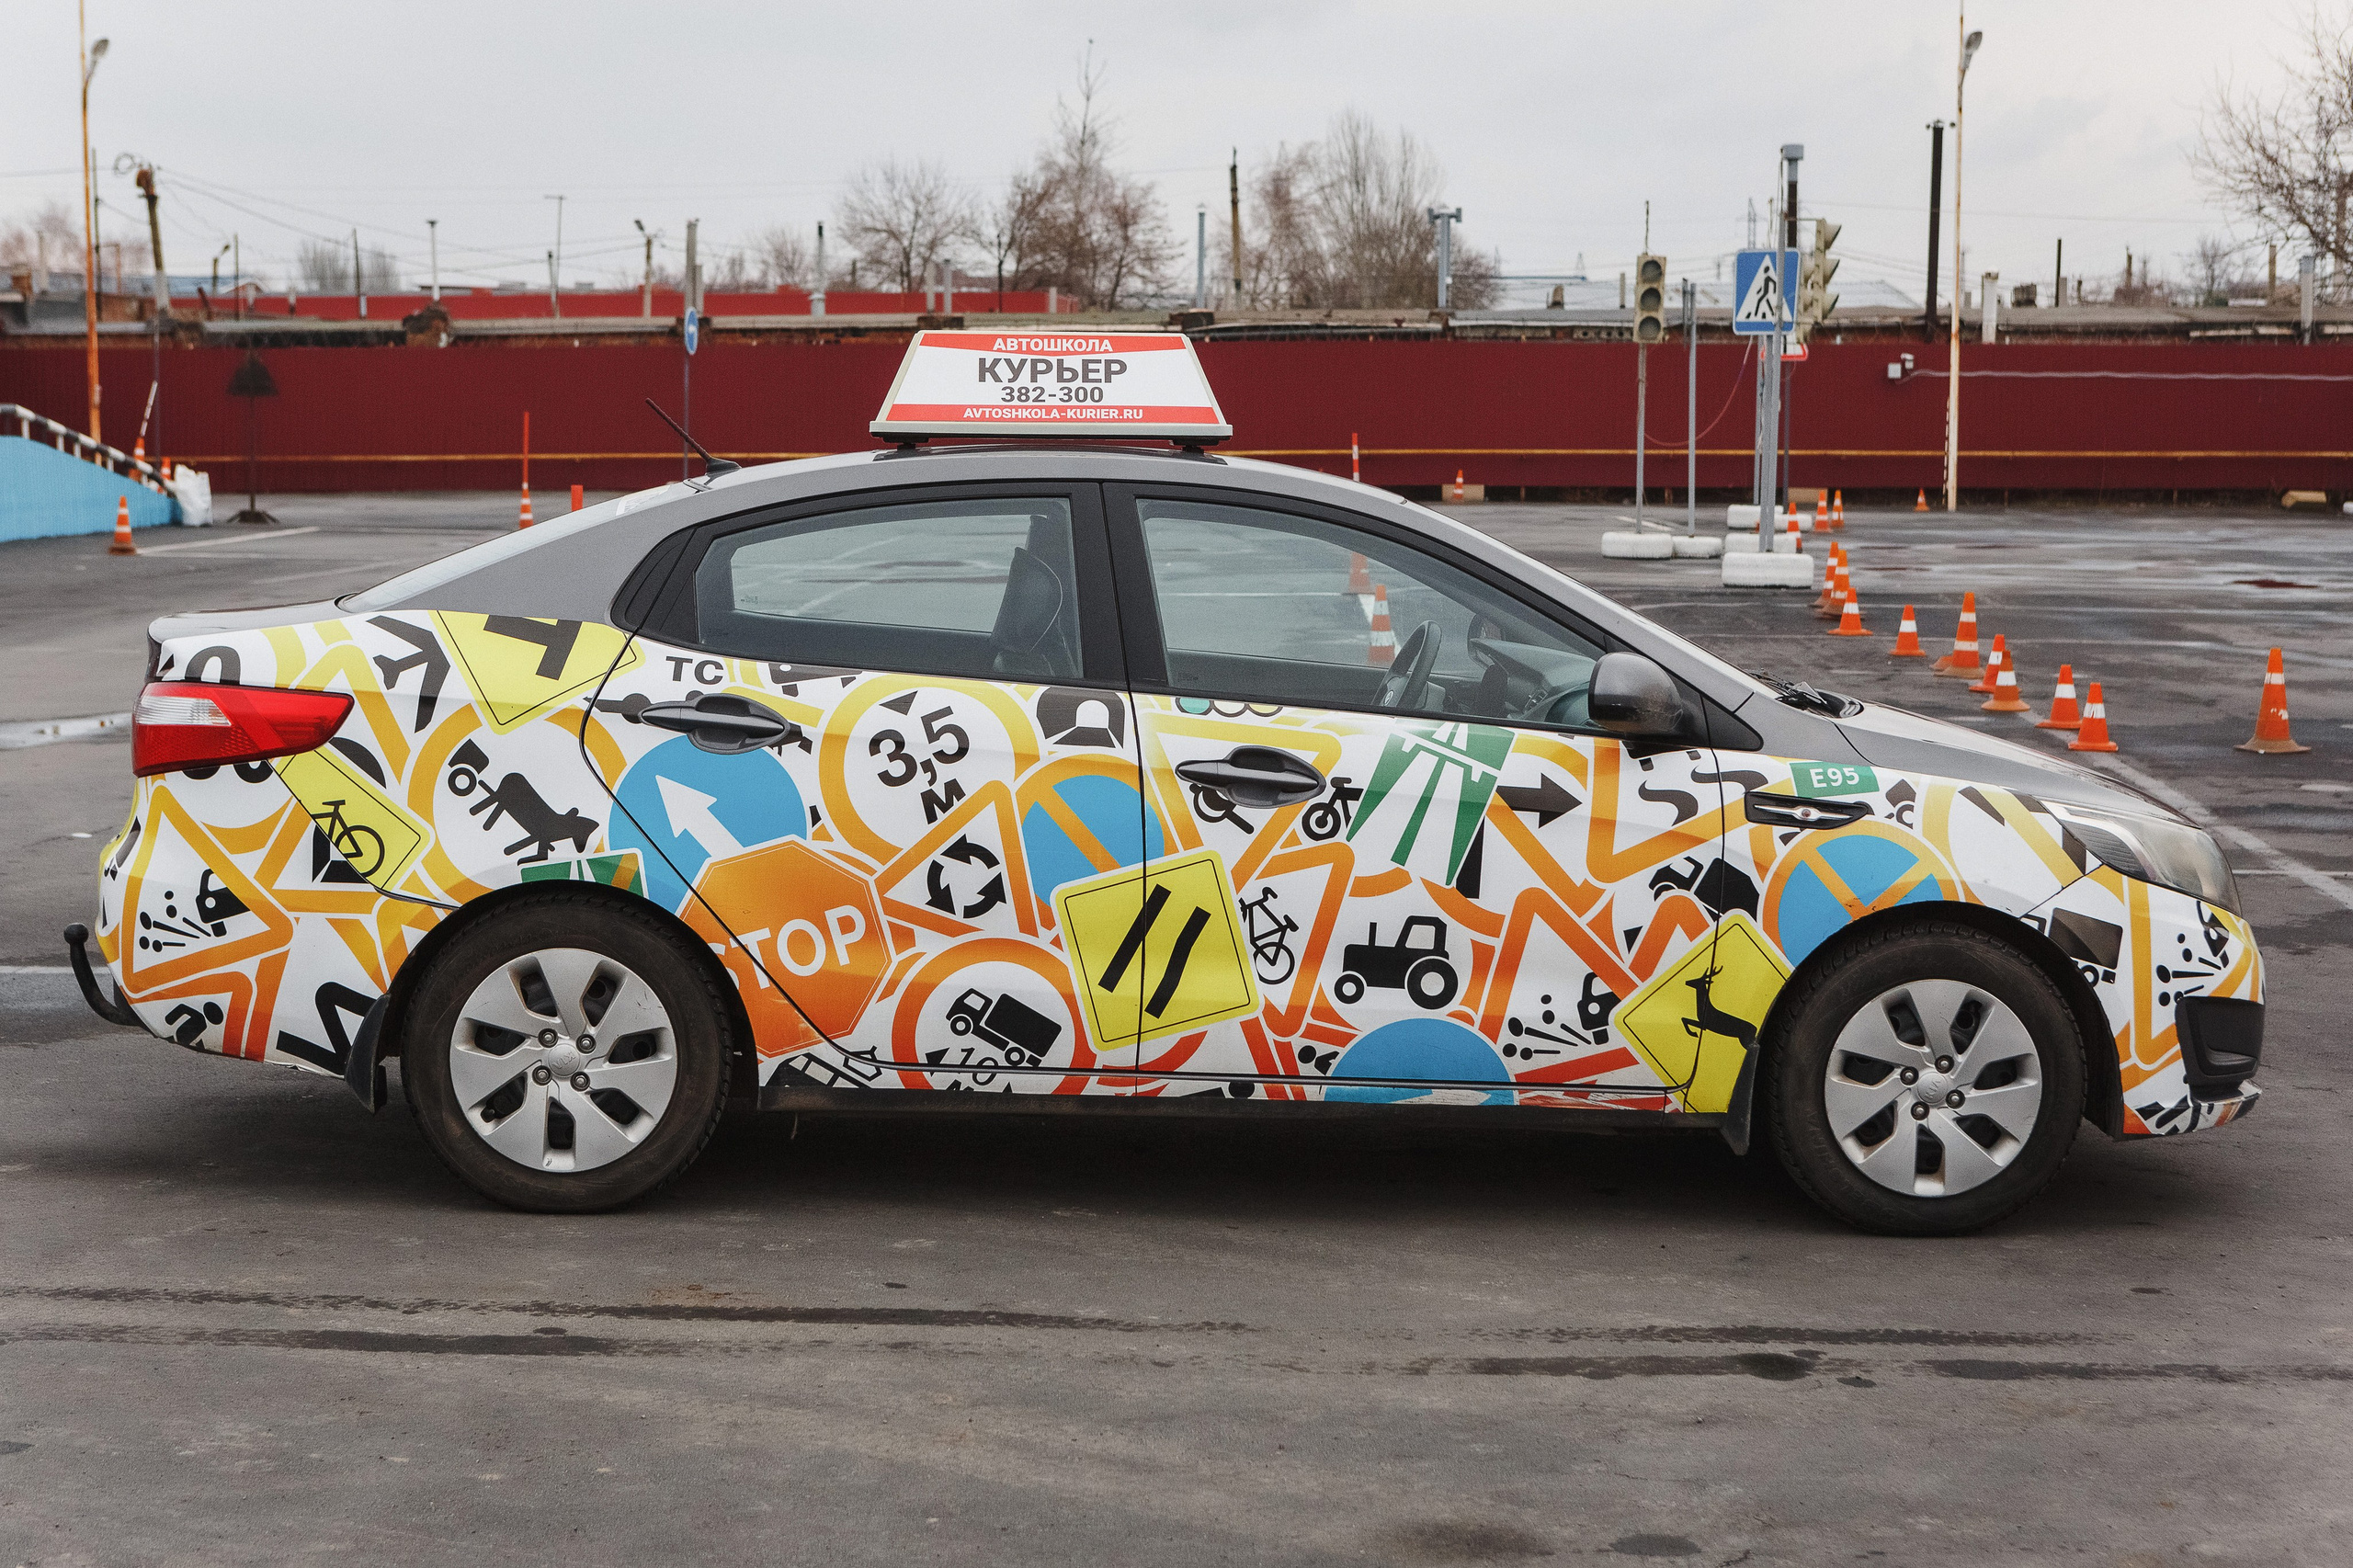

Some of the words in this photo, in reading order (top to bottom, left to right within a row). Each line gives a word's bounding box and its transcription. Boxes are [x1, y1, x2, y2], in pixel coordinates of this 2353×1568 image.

[993, 337, 1113, 353] АВТОШКОЛА
[977, 357, 1128, 384] КУРЬЕР
[1000, 386, 1104, 403] 382-300
[963, 406, 1143, 419] AVTOSHKOLA-KURIER.RU
[868, 705, 971, 788] 3,5
[1809, 767, 1860, 789] E95
